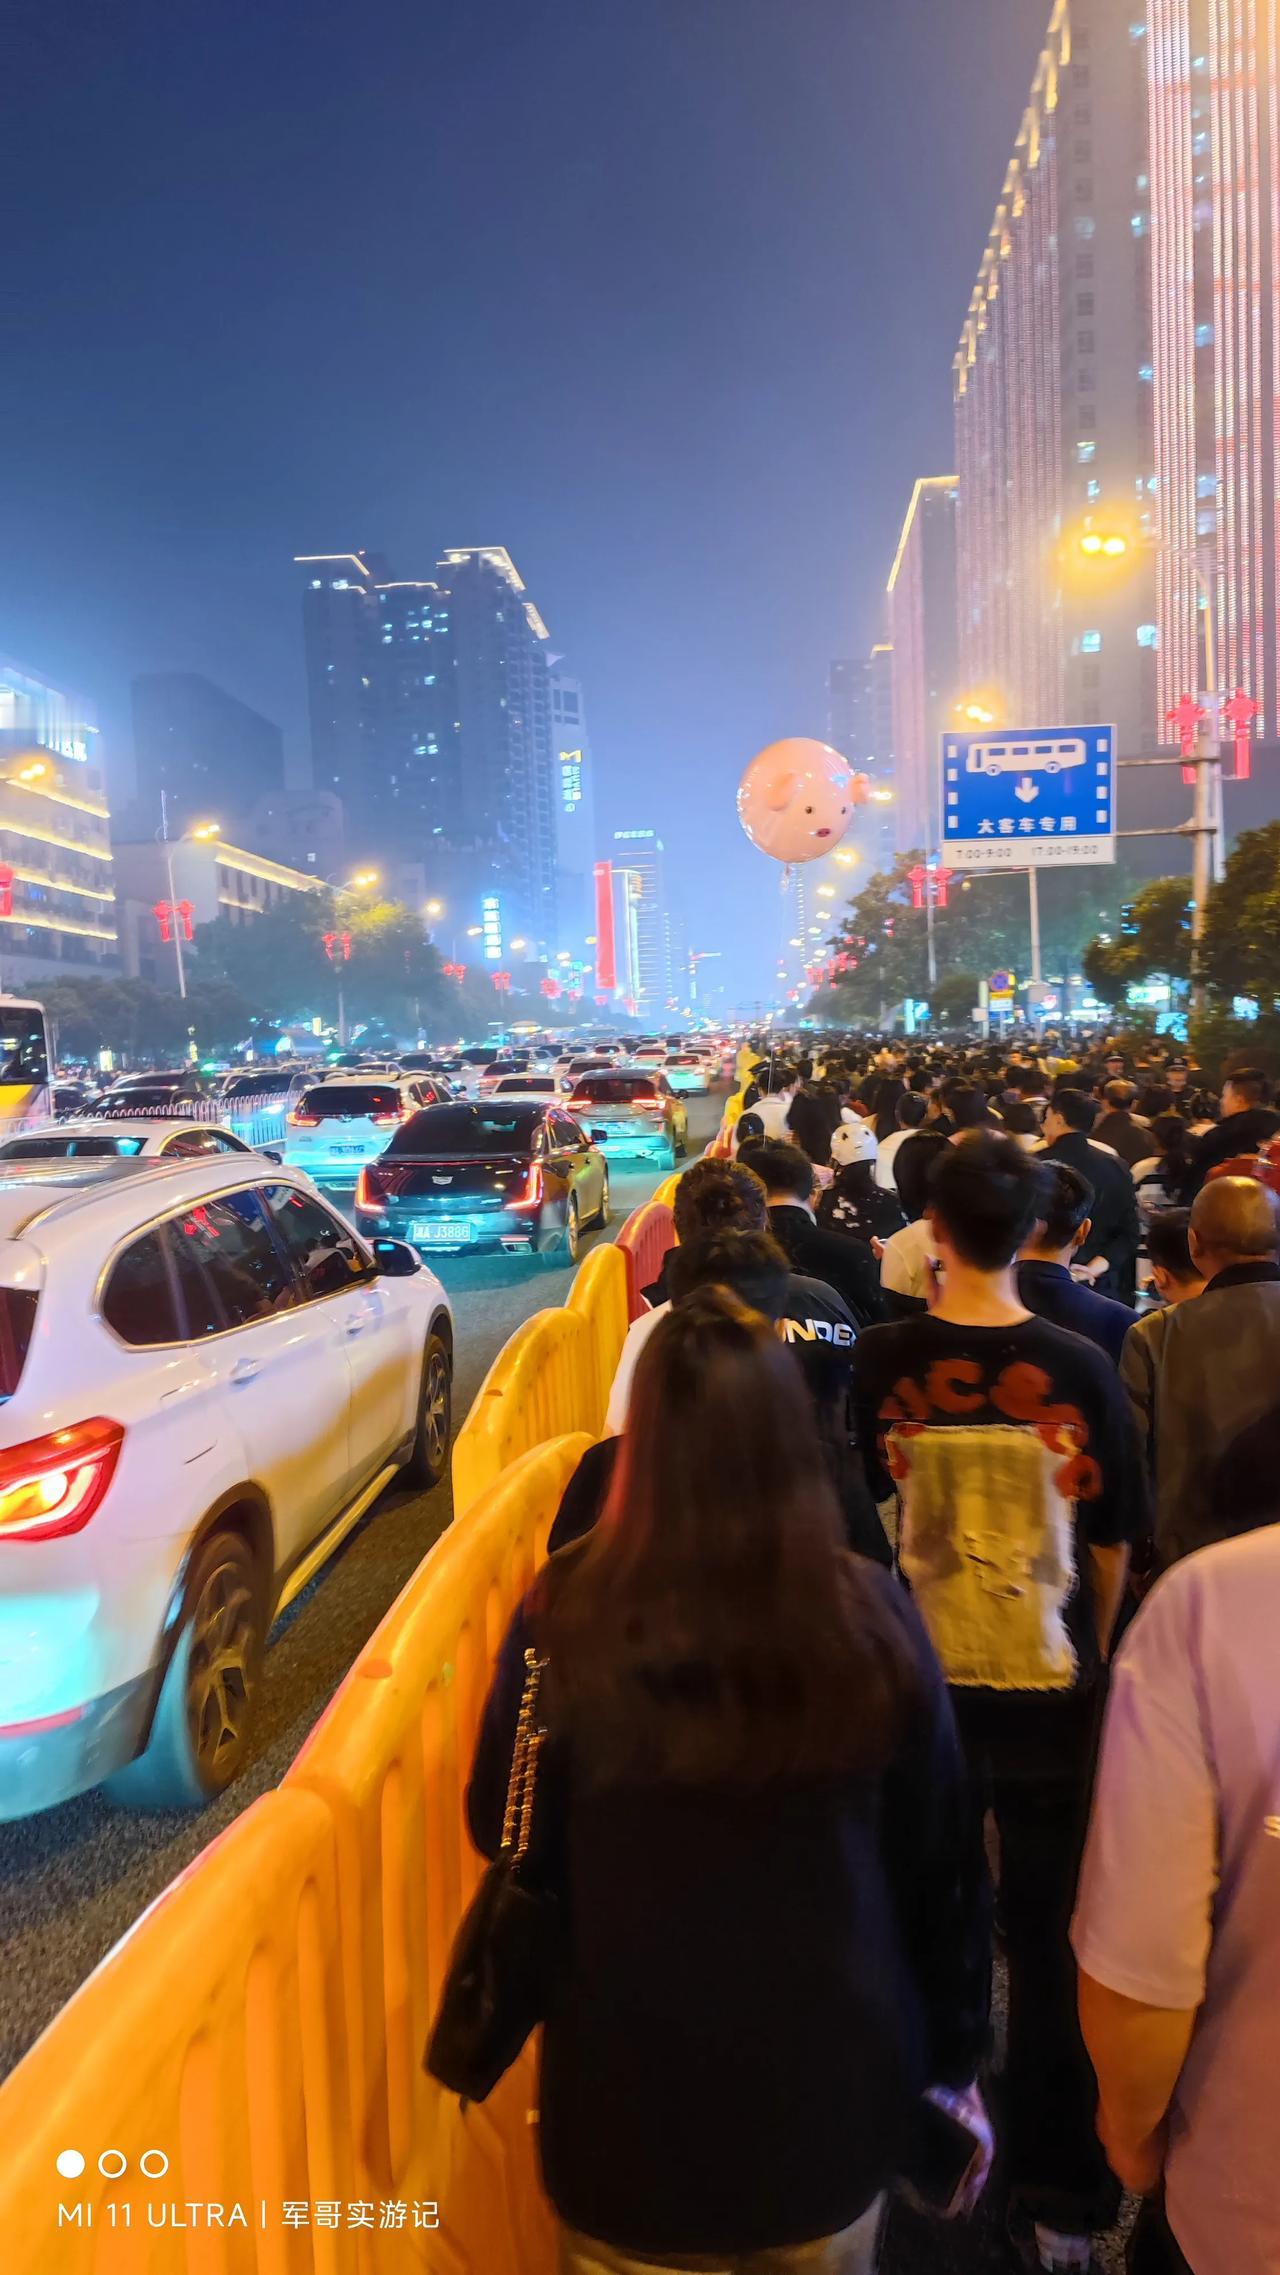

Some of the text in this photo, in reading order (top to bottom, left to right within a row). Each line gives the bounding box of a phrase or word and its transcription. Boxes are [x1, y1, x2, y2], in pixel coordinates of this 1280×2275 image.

[977, 816, 1077, 834] 大客车专用
